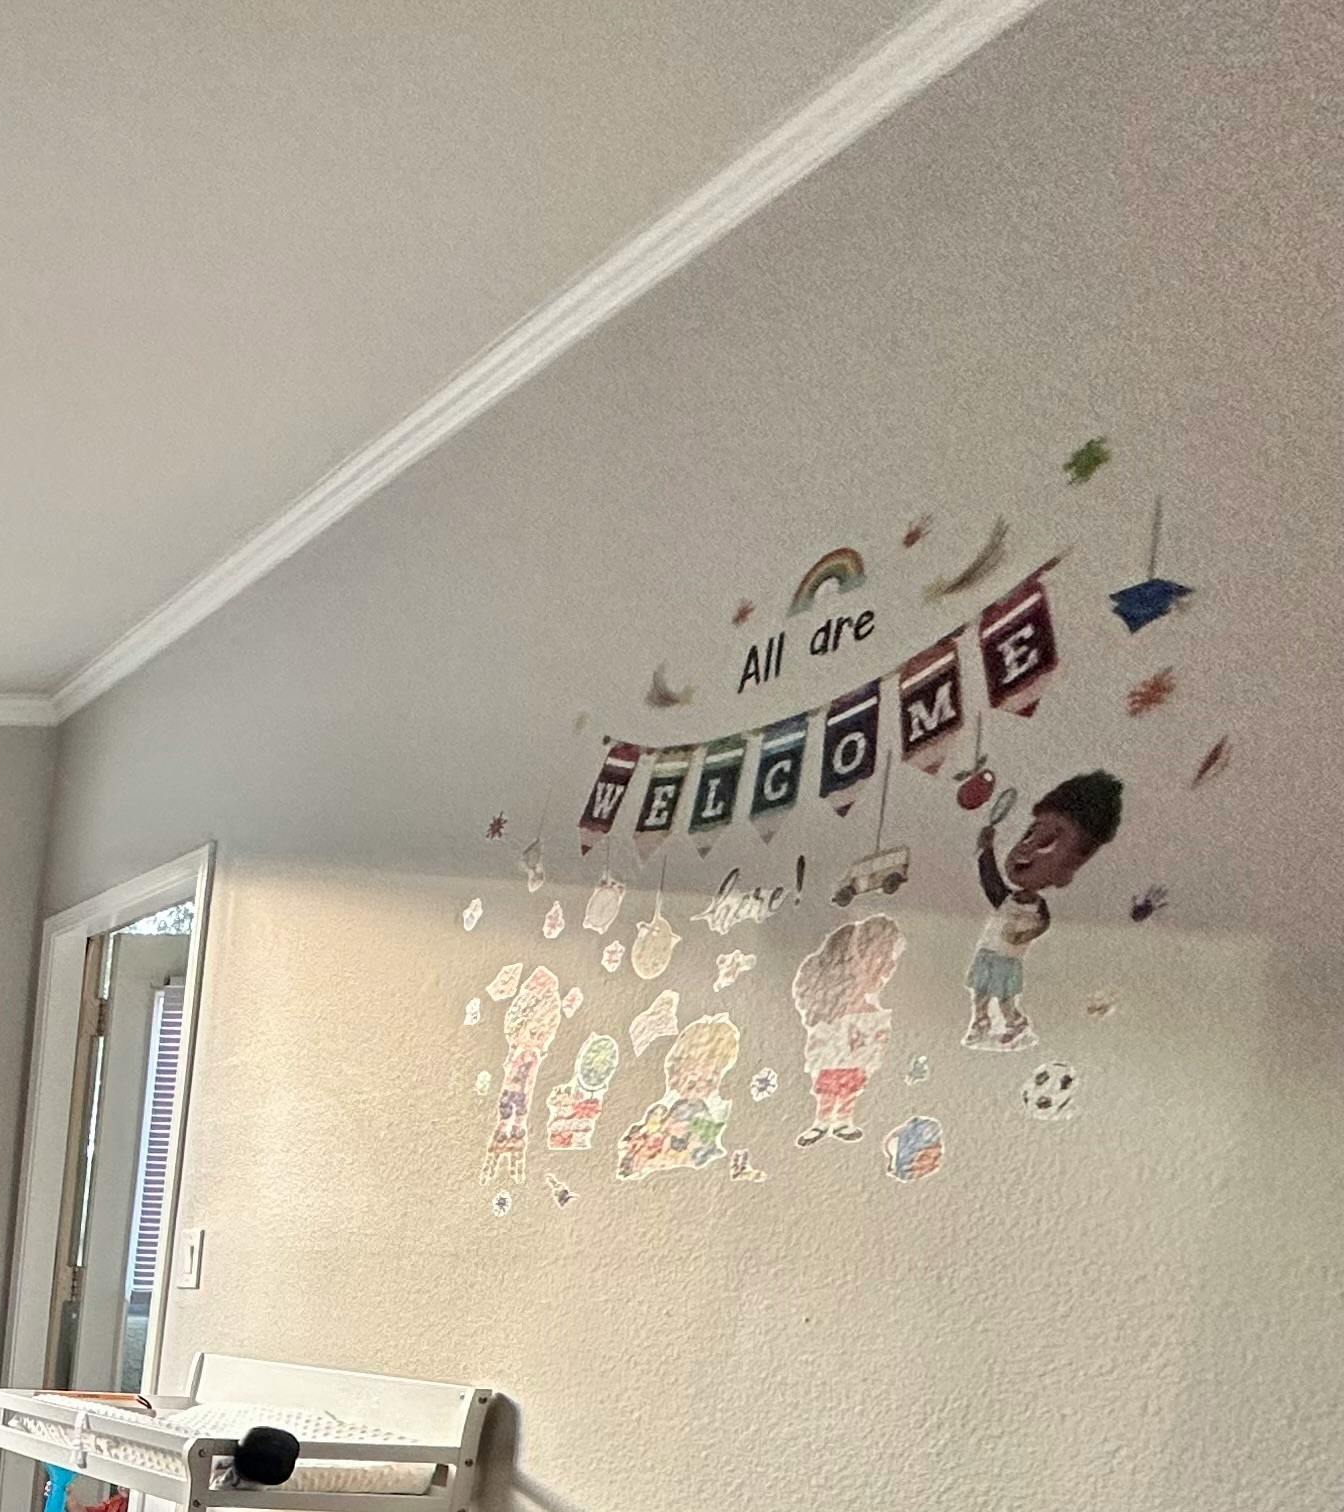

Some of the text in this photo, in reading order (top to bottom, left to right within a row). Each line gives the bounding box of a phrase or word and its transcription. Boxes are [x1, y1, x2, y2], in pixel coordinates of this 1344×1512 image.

[738, 609, 876, 694] All are
[591, 623, 1040, 828] WELCOME
